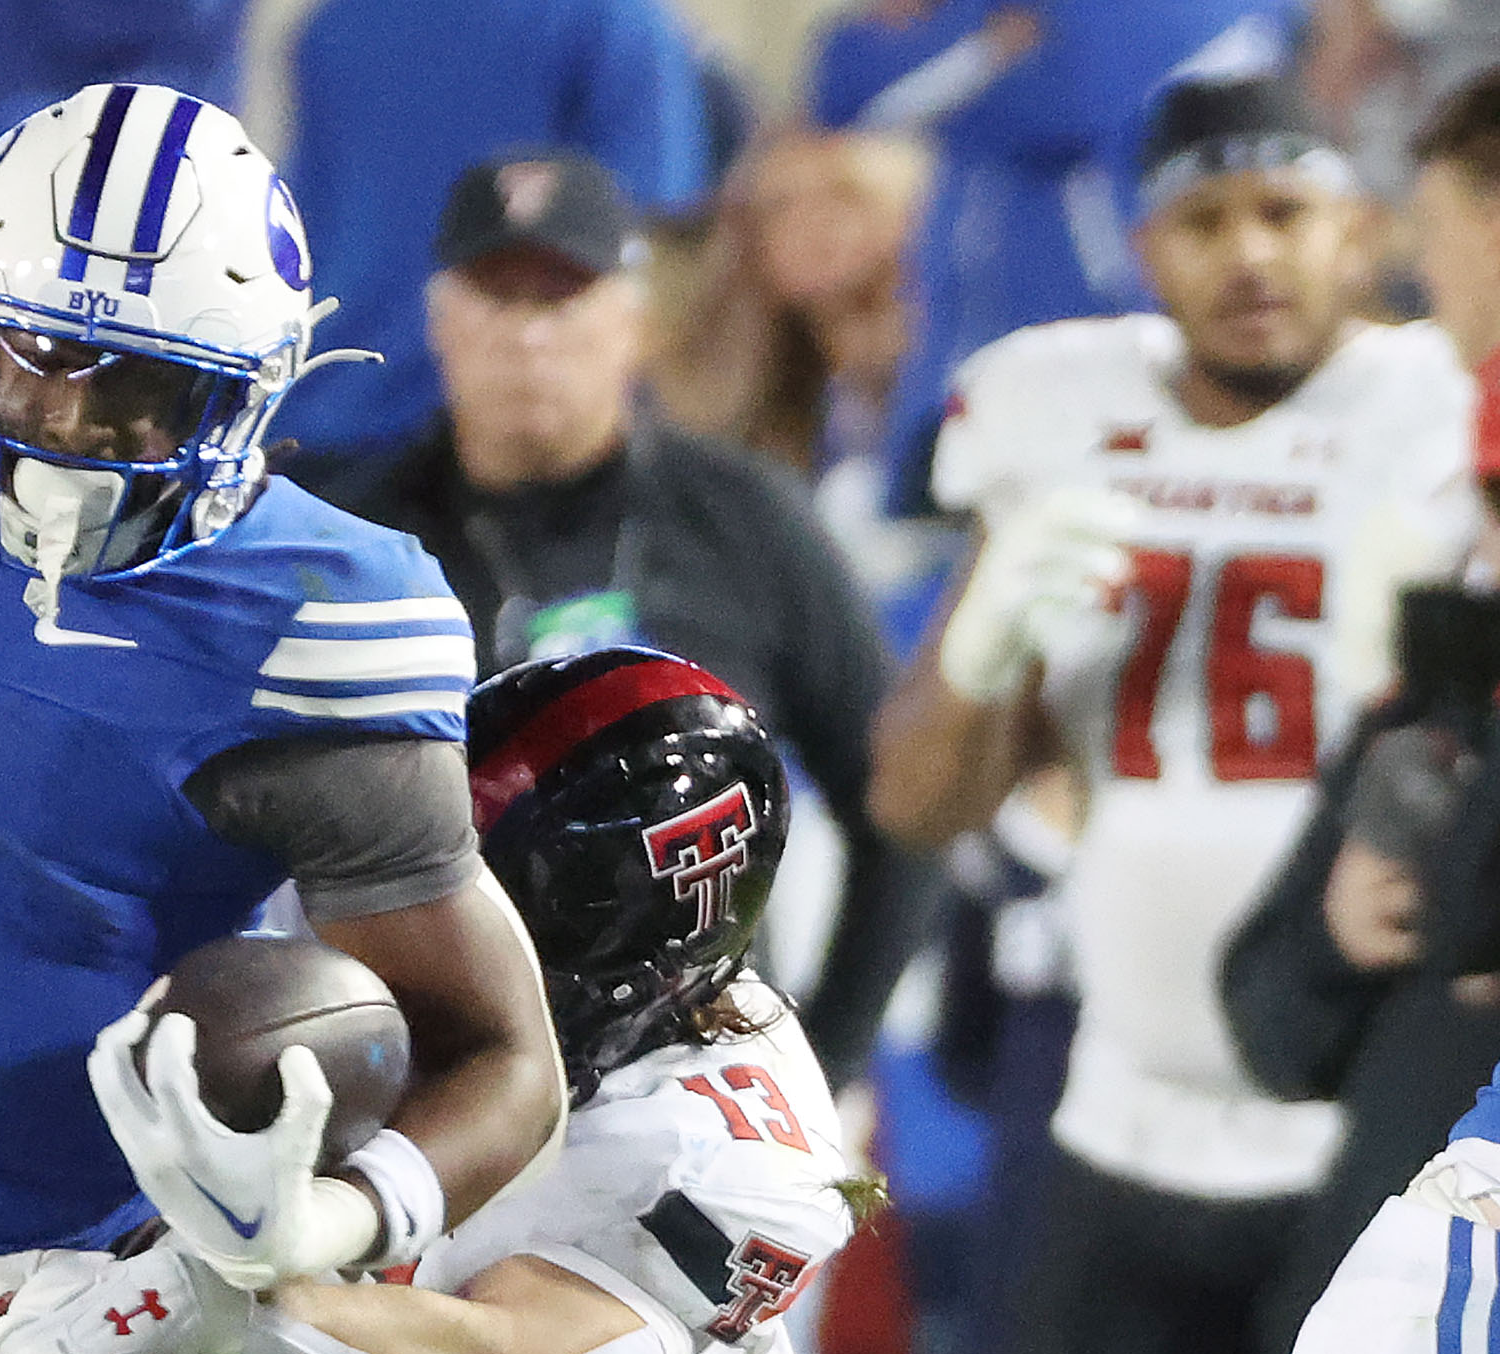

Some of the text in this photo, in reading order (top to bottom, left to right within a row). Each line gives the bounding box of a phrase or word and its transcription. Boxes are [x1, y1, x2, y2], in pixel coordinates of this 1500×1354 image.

[67, 288, 120, 317] BYU
[1102, 548, 1323, 780] 76
[677, 1063, 812, 1155] 13
